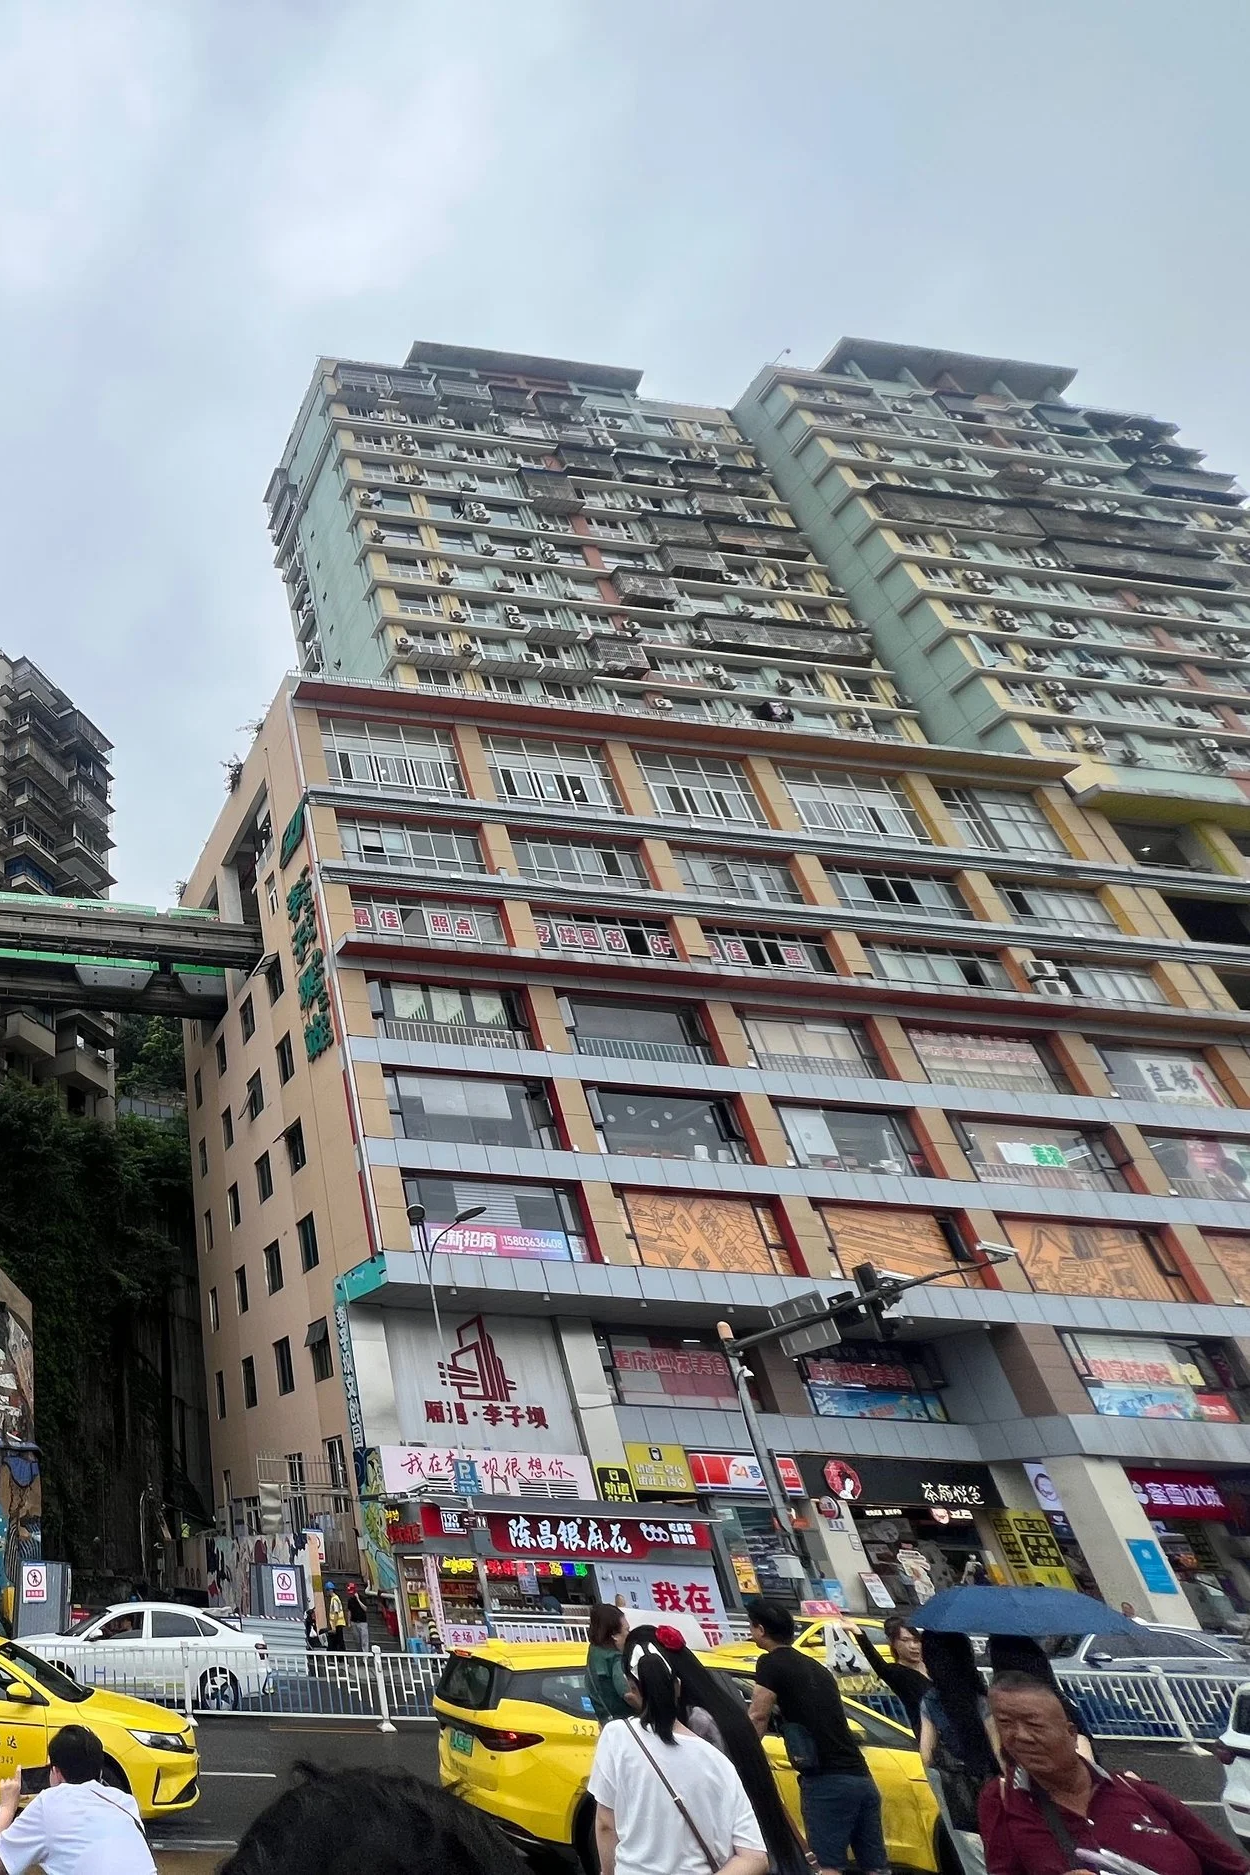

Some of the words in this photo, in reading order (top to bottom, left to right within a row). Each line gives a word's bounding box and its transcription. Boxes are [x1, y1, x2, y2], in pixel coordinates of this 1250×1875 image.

[1145, 1062, 1199, 1094] 直梯
[458, 1462, 470, 1479] P
[1145, 1482, 1225, 1508] 蜜雪冰城
[507, 1515, 633, 1554] 陈昌银麻花
[651, 1580, 716, 1615] 我在
[451, 1630, 473, 1643] 全场
